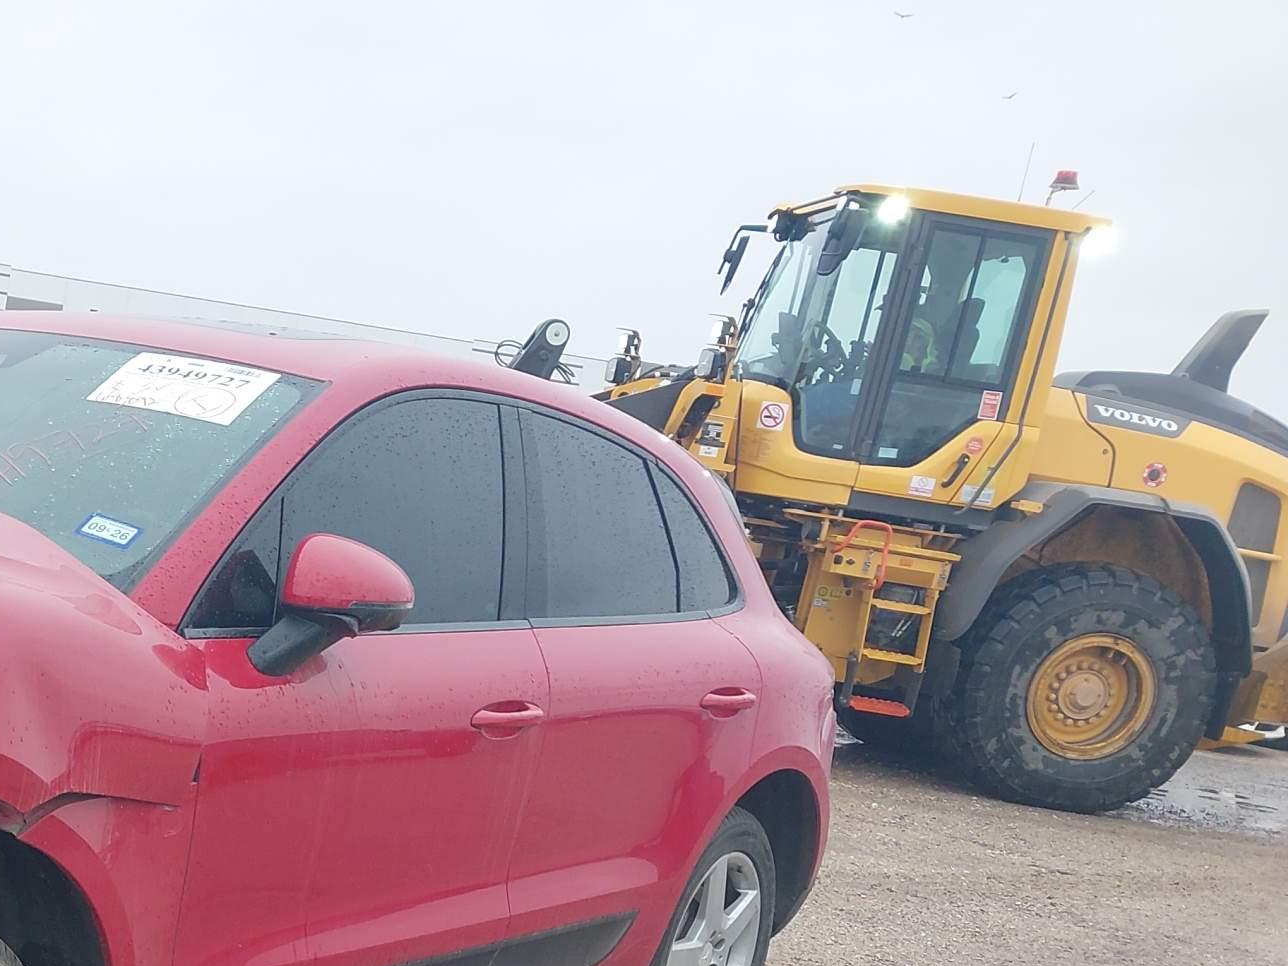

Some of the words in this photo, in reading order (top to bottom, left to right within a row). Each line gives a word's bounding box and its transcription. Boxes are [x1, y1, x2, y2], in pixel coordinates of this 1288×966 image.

[137, 362, 252, 390] 43949727
[1093, 404, 1178, 431] VOLVO
[87, 521, 107, 534] 09
[109, 528, 131, 541] 26
